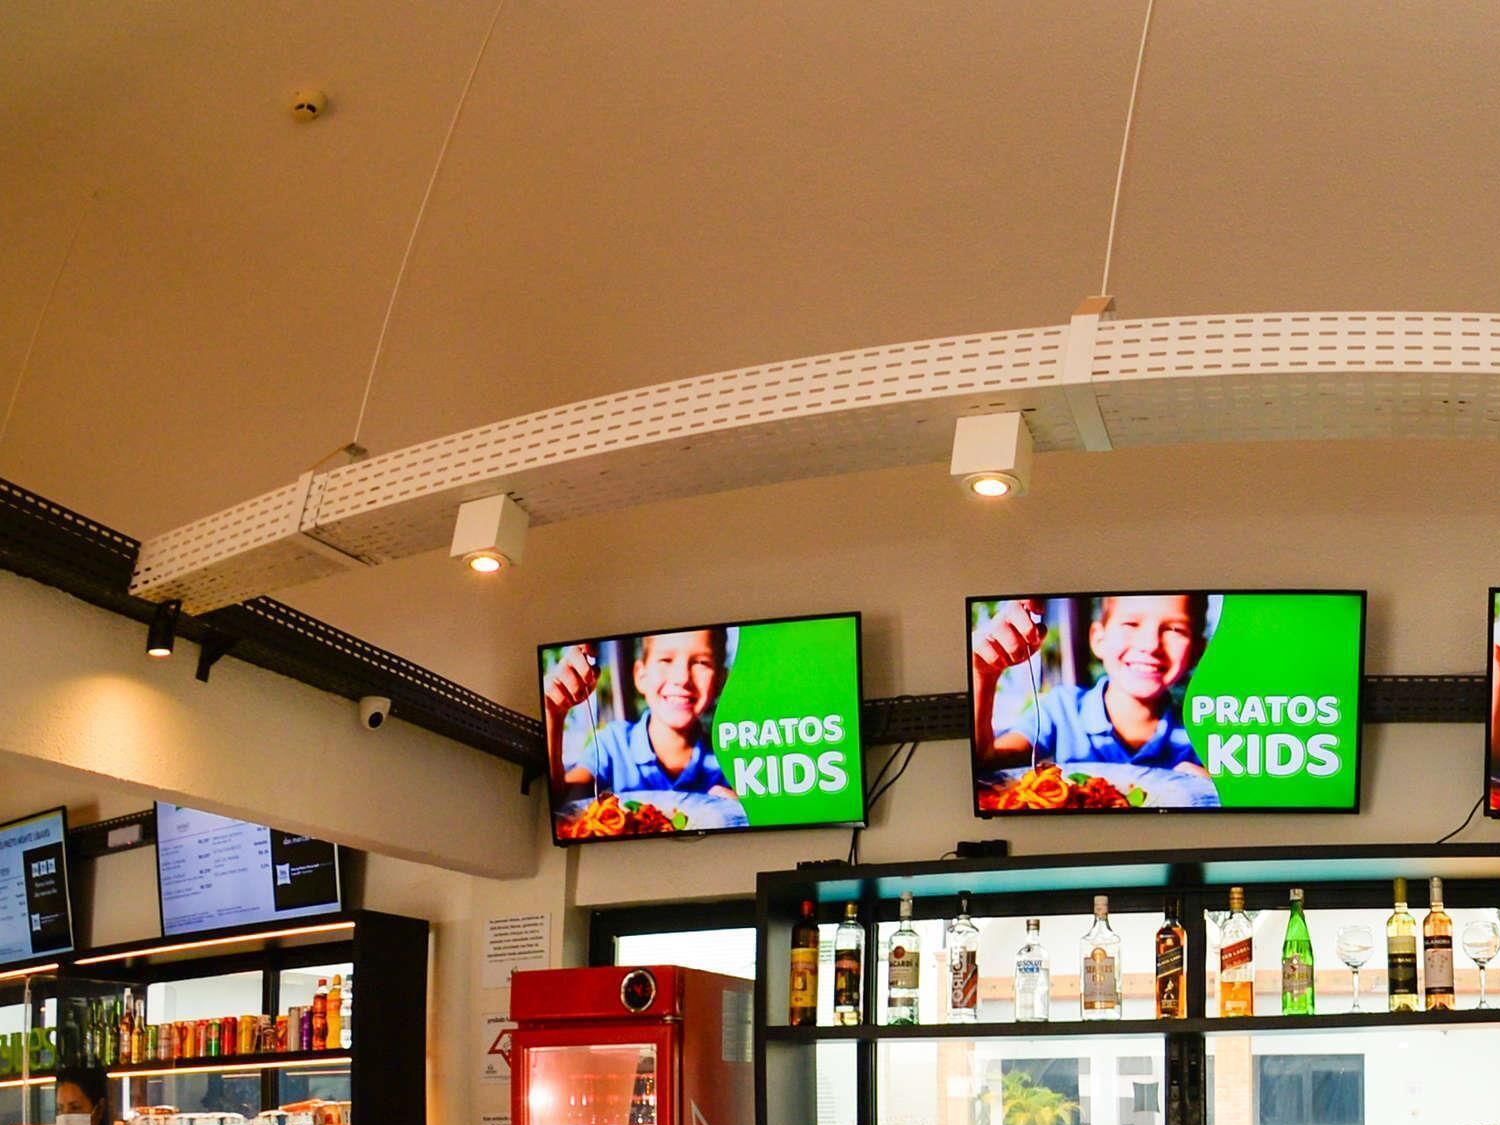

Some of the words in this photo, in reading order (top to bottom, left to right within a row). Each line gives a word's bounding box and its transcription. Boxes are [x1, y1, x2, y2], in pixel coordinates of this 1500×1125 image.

[1192, 695, 1340, 725] PRATOS
[718, 714, 844, 749] PRATOS
[733, 750, 848, 797] KIDS
[1207, 733, 1341, 777] KIDS
